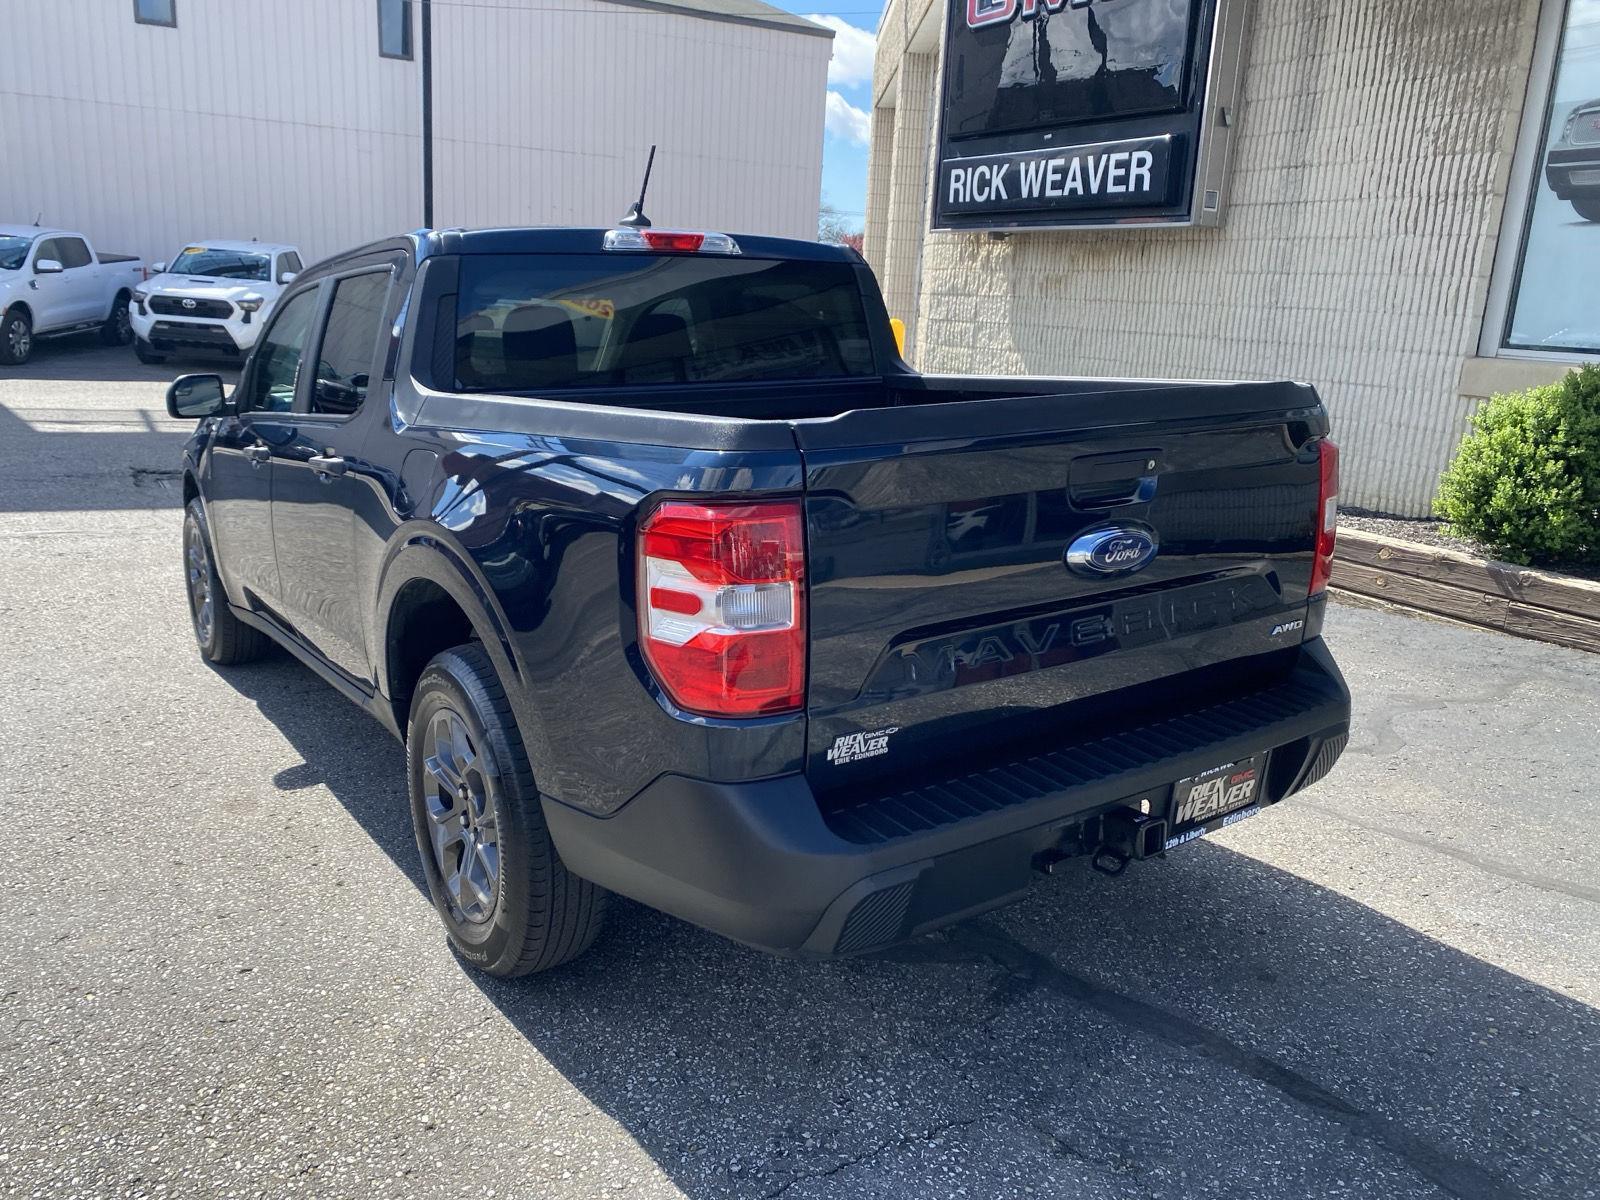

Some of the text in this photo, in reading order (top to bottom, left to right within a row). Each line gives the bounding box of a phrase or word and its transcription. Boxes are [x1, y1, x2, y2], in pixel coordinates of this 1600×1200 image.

[949, 150, 1153, 203] RICK WEAVER
[1105, 539, 1142, 563] Ford
[1271, 620, 1303, 635] AWD
[827, 736, 889, 760] WEAVER
[834, 730, 885, 748] RICK GMC
[834, 747, 889, 765] ERIE EDINBORO
[1187, 775, 1228, 803] RICK
[1231, 768, 1255, 784] GMC
[1175, 779, 1256, 824] WEAVER
[1222, 806, 1261, 827] Edinboro
[1186, 827, 1207, 841] Liberty
